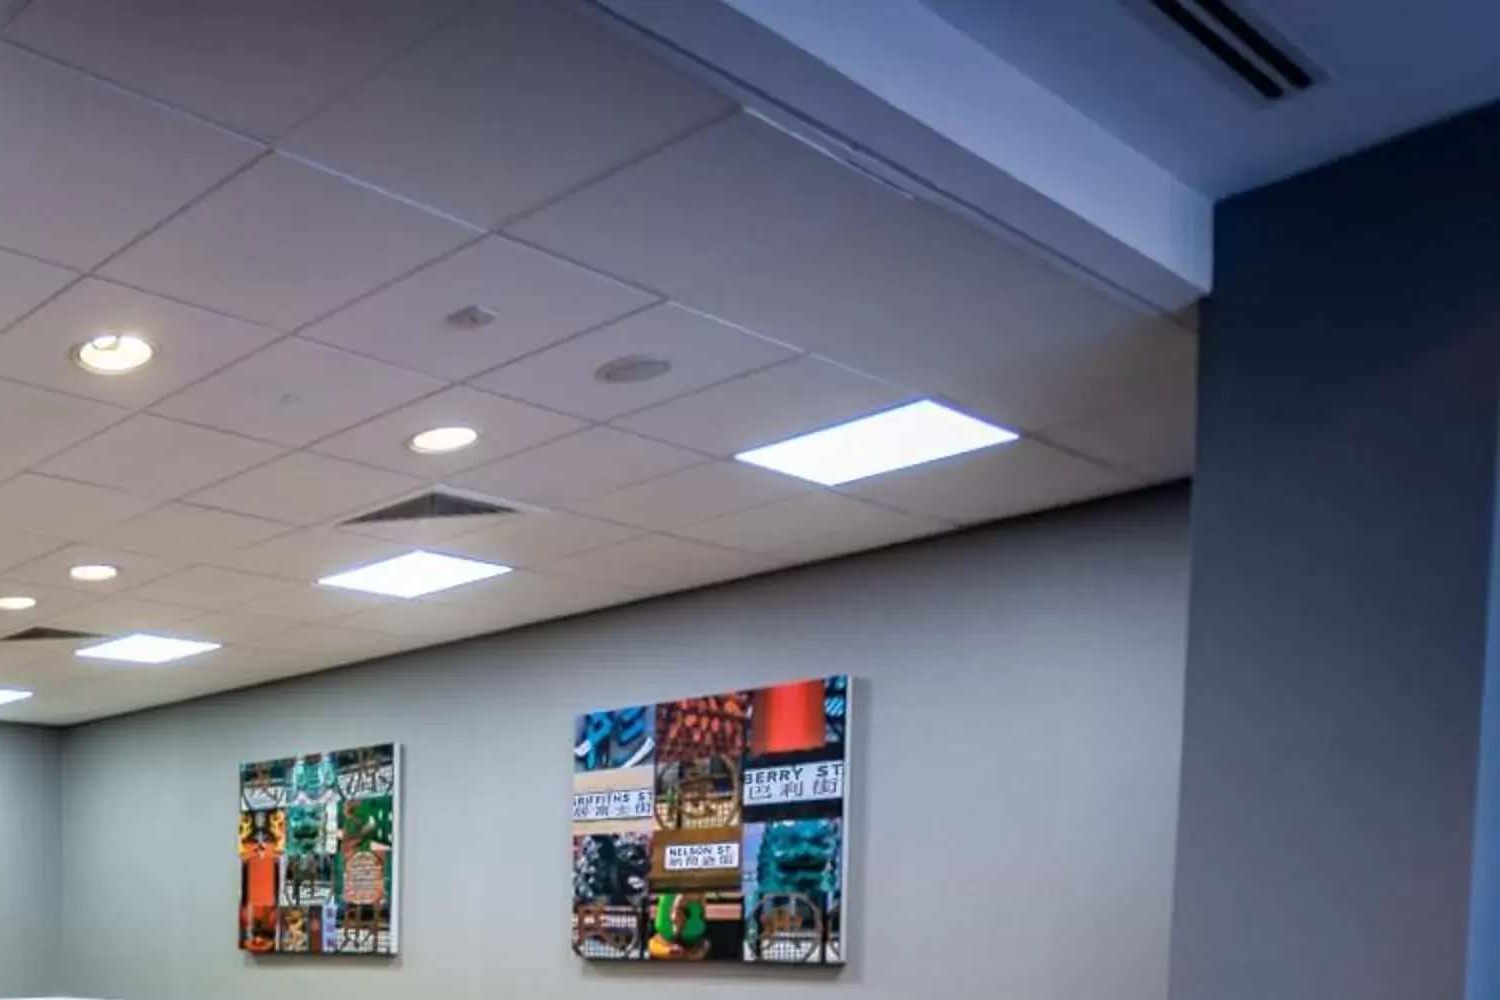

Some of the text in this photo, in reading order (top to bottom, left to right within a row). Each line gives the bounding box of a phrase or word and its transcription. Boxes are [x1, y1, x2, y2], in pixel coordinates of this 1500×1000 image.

[744, 763, 844, 785] BERRY ST
[669, 843, 732, 857] NELSON ST
